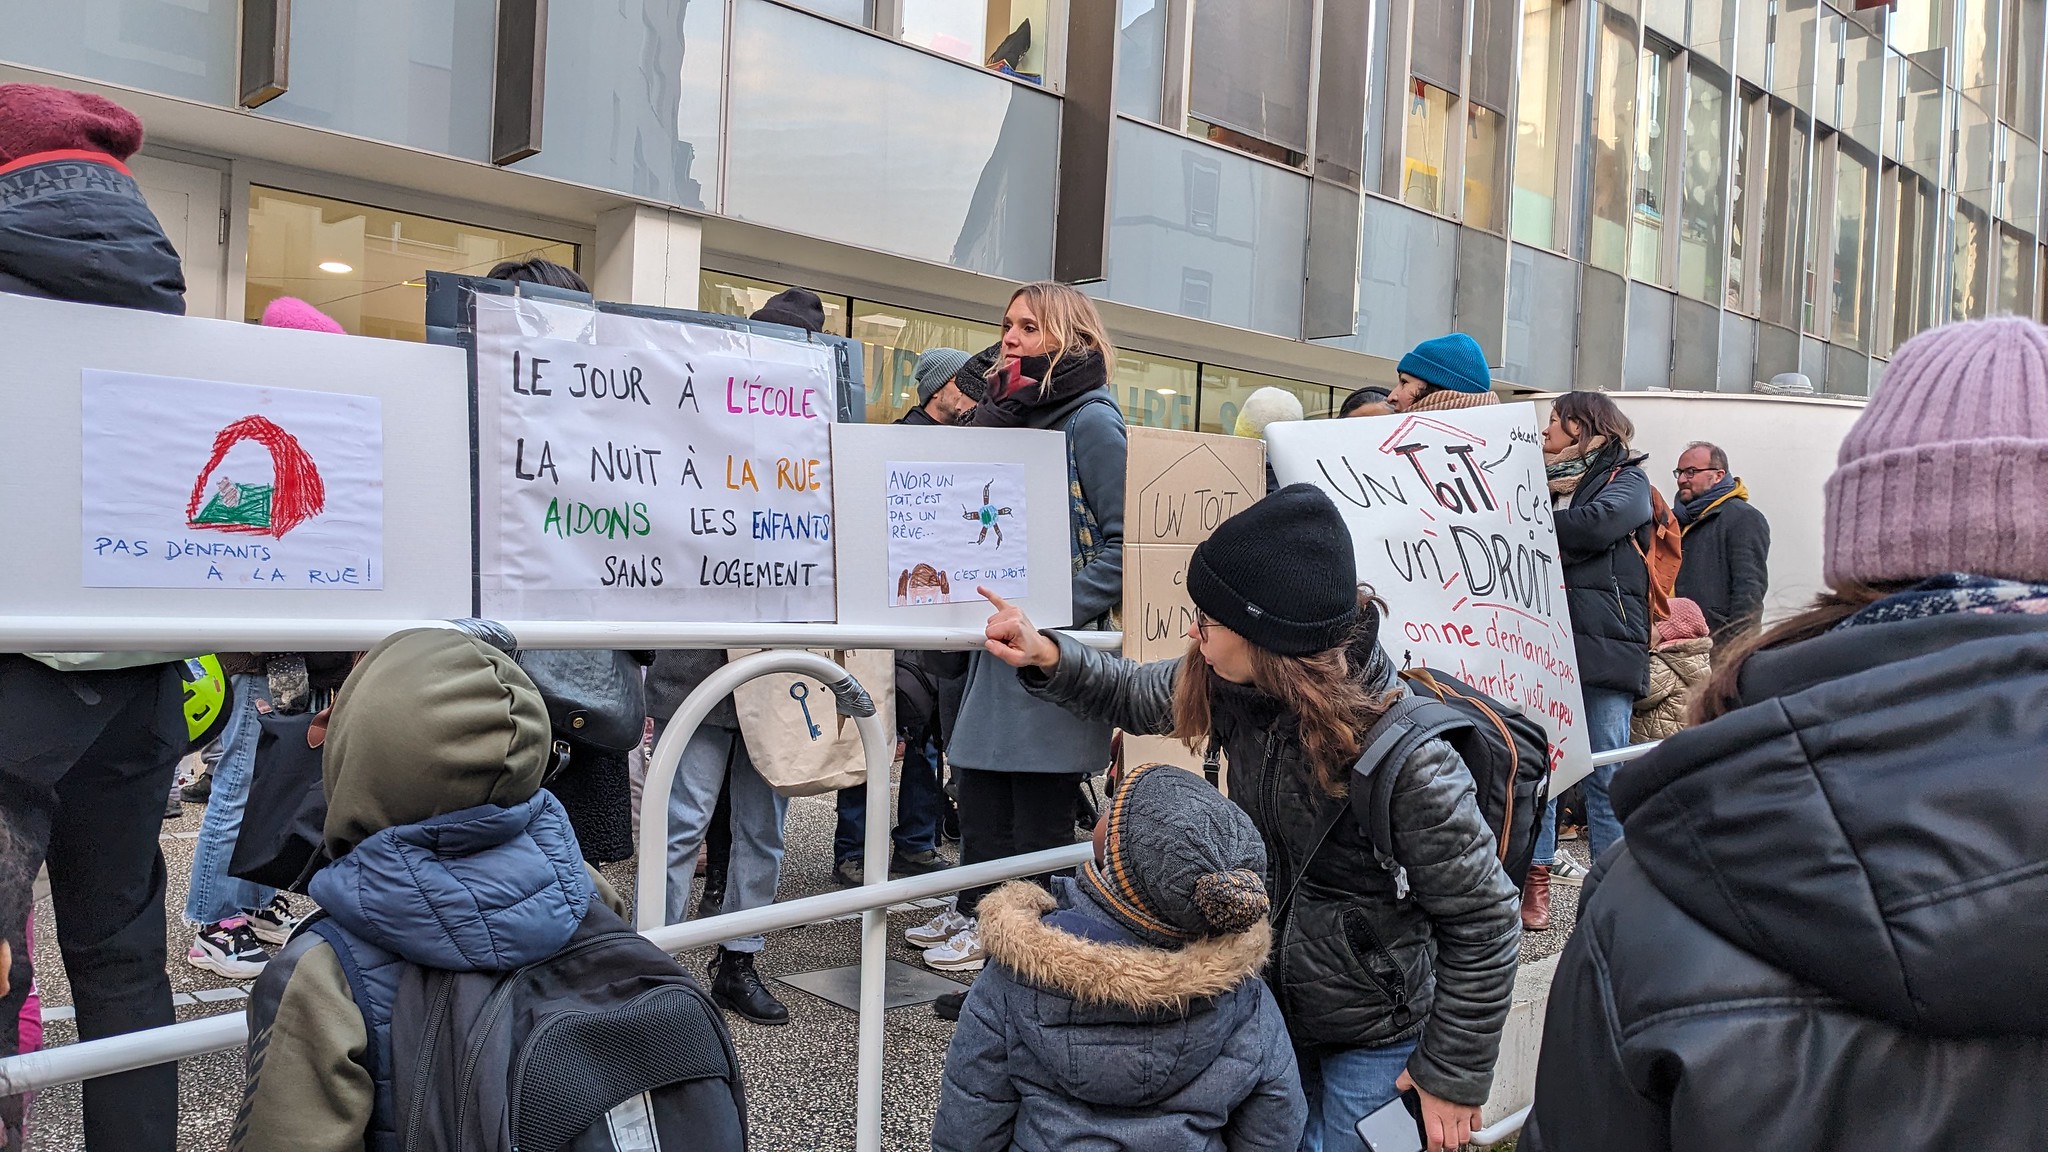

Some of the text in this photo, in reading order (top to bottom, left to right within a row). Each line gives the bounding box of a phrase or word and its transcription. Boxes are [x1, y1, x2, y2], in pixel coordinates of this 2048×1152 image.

[513, 350, 552, 396] LE
[569, 363, 651, 405] JOUR
[678, 362, 699, 413] À
[726, 375, 818, 418] L'ÉCOLE
[515, 438, 559, 486] LA
[681, 445, 702, 489] À
[726, 455, 759, 492] LA
[776, 457, 821, 492] RUE
[889, 471, 954, 490] AVOIR UN
[544, 497, 831, 541] AIDONS LES ENFANTS
[890, 510, 936, 523] PAS UN
[1154, 493, 1186, 538] UN
[95, 537, 271, 561] PAS D'ENFANTS
[207, 561, 223, 581] À
[253, 568, 285, 581] LA
[600, 555, 818, 588] SANS LOGEMENT
[984, 570, 997, 580] UN
[1146, 602, 1173, 642] UN
[1455, 659, 1518, 702] harité
